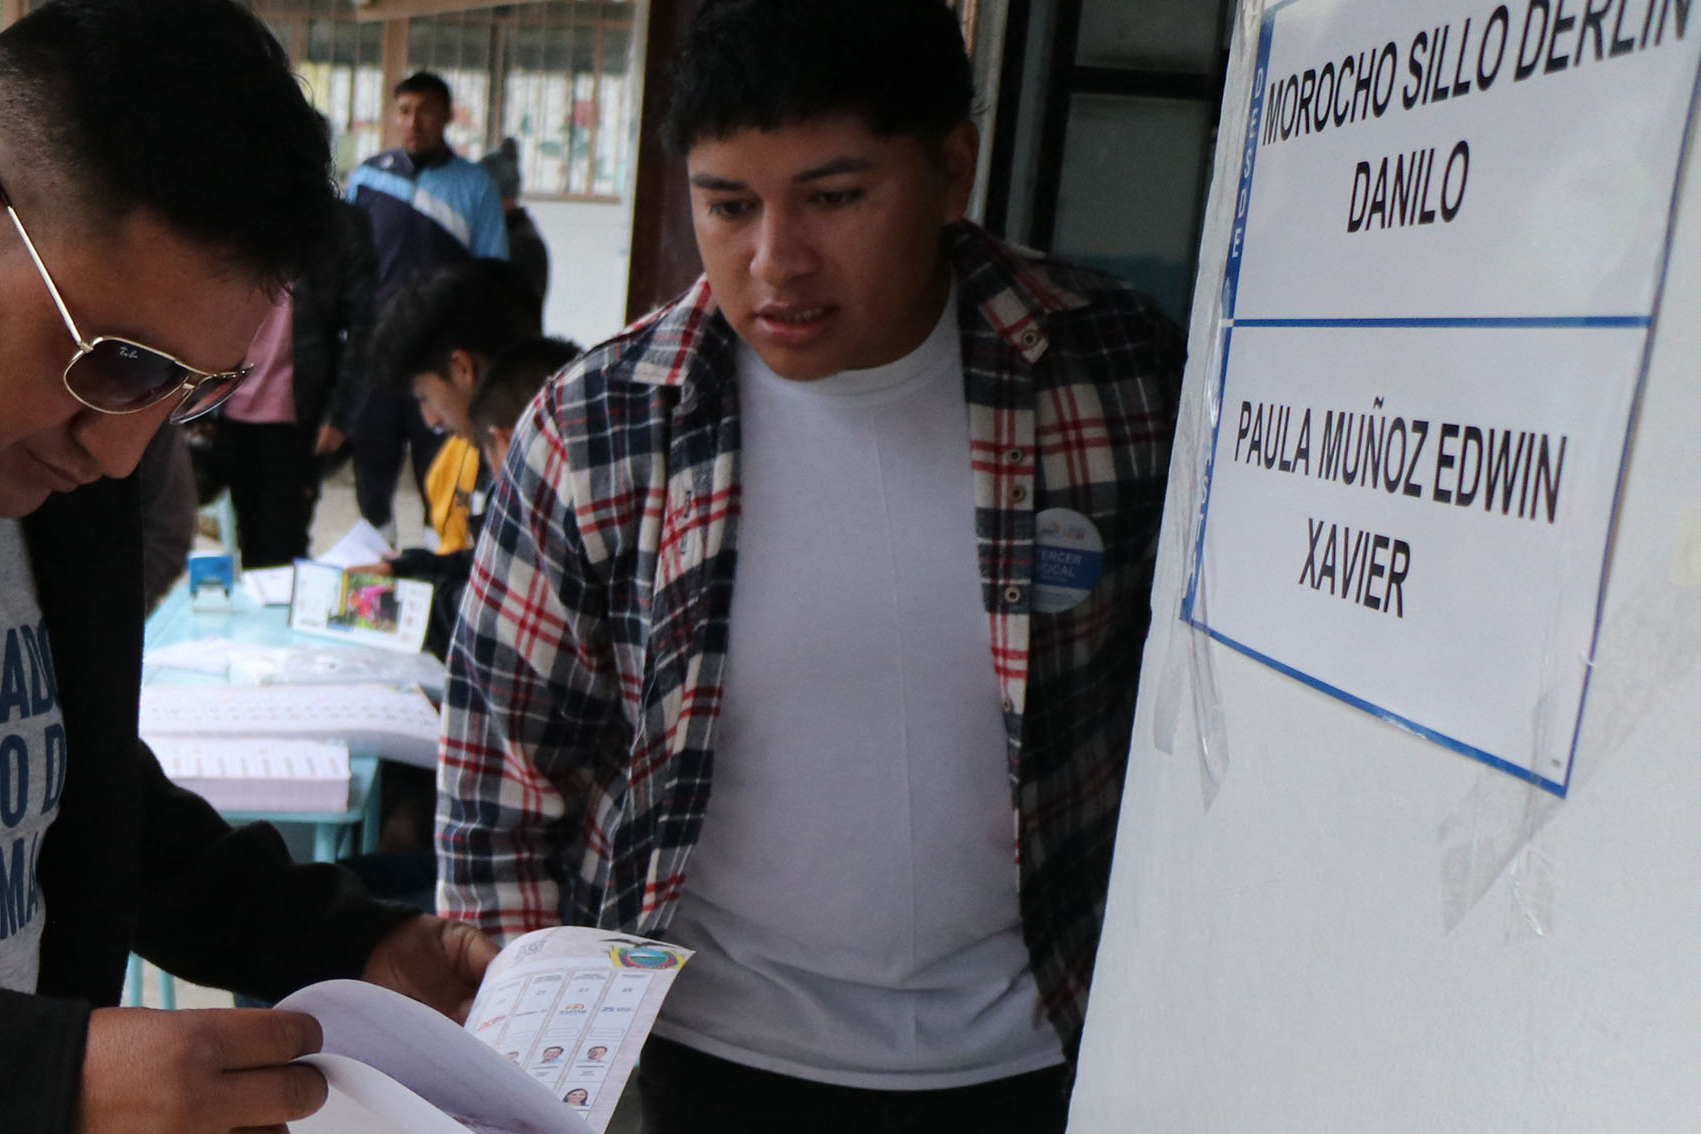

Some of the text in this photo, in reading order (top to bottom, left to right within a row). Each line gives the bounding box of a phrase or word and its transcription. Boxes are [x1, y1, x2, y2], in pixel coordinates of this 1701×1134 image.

[1262, 0, 1693, 146] MOROCHO SILLO DERLIN
[1347, 140, 1469, 233] DANILO
[1234, 396, 1567, 524] PAULA MUÑOZ EDWIN
[1298, 517, 1411, 618] XAVIER
